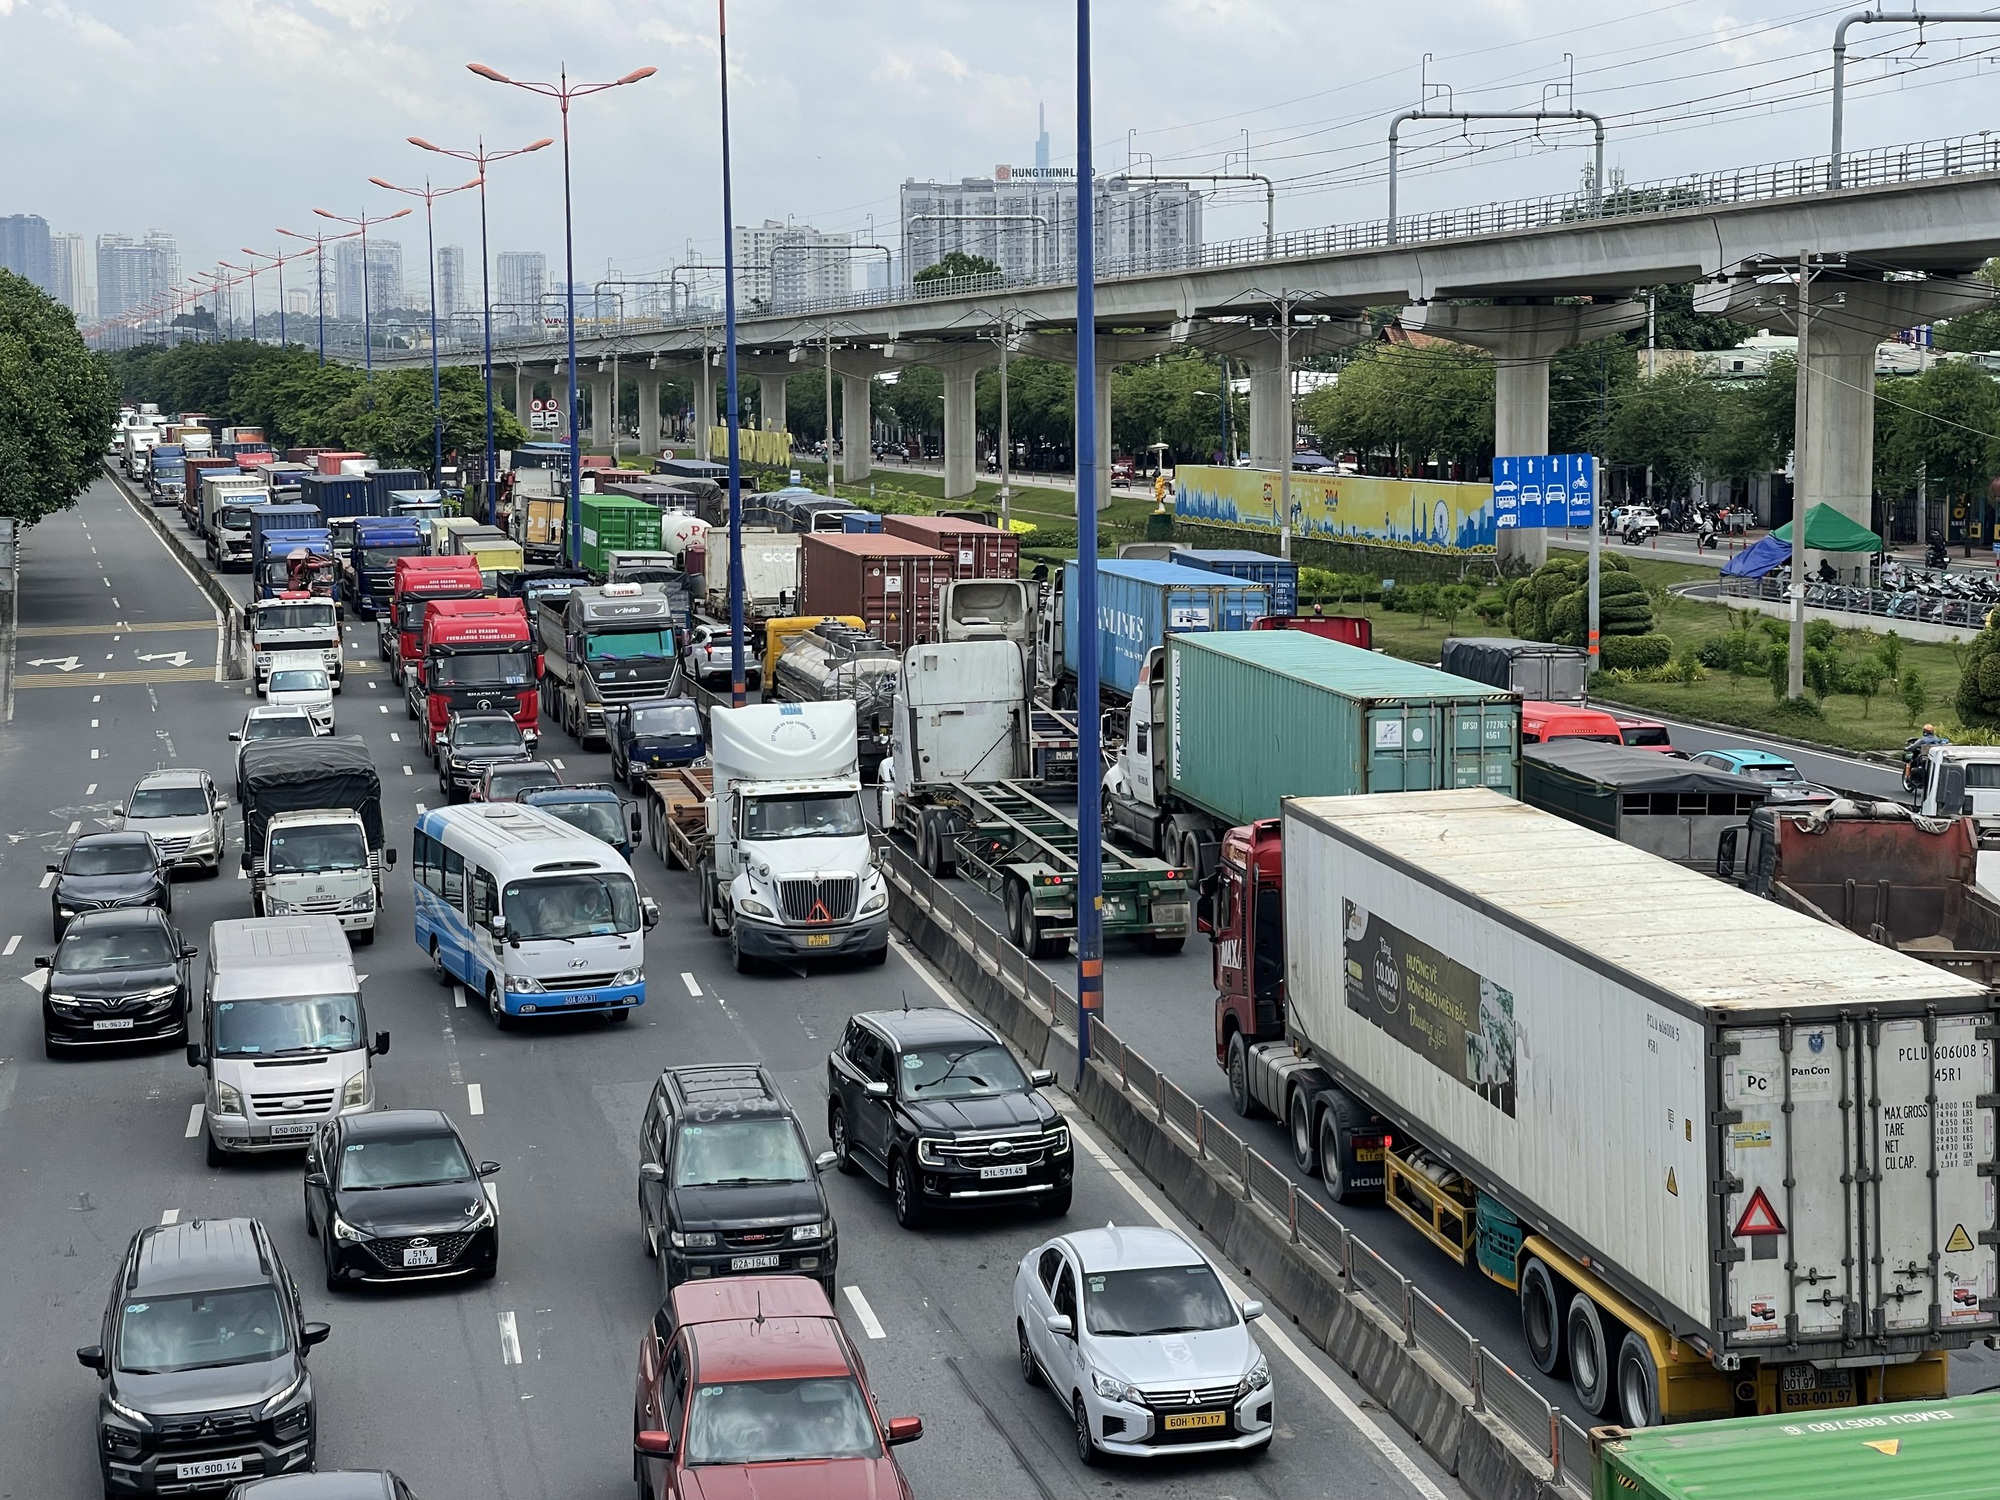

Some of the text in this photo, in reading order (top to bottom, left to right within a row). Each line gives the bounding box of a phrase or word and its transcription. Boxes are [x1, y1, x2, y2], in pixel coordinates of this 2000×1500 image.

[1012, 168, 1038, 178] HUNG
[1070, 168, 1096, 177] LD
[1462, 721, 1478, 730] DFSU
[1486, 720, 1508, 729] 772763
[1486, 731, 1500, 740] 45G1
[1376, 960, 1399, 990] 10.000
[1899, 1043, 1989, 1062] PCLU 606008 5
[1791, 1066, 1830, 1076] PanCon
[1934, 1067, 1962, 1082] 45R1
[1748, 1076, 1767, 1090] PC
[1884, 1122, 1905, 1136] TARE
[1884, 1140, 1900, 1154] NET
[1962, 1134, 1973, 1142] KGS
[1962, 1142, 1974, 1150] LBS
[1351, 1178, 1386, 1187] HOW
[412, 1250, 428, 1258] 51K
[407, 1257, 434, 1265] 401.74
[1790, 1366, 1808, 1378] 63R
[1784, 1377, 1814, 1390] 001.97
[1786, 1390, 1851, 1406] 63R-001.97
[1170, 1415, 1220, 1427] 60H-170.17
[1889, 1410, 1955, 1425] EMCU
[182, 1462, 237, 1476] 51K-900.14
